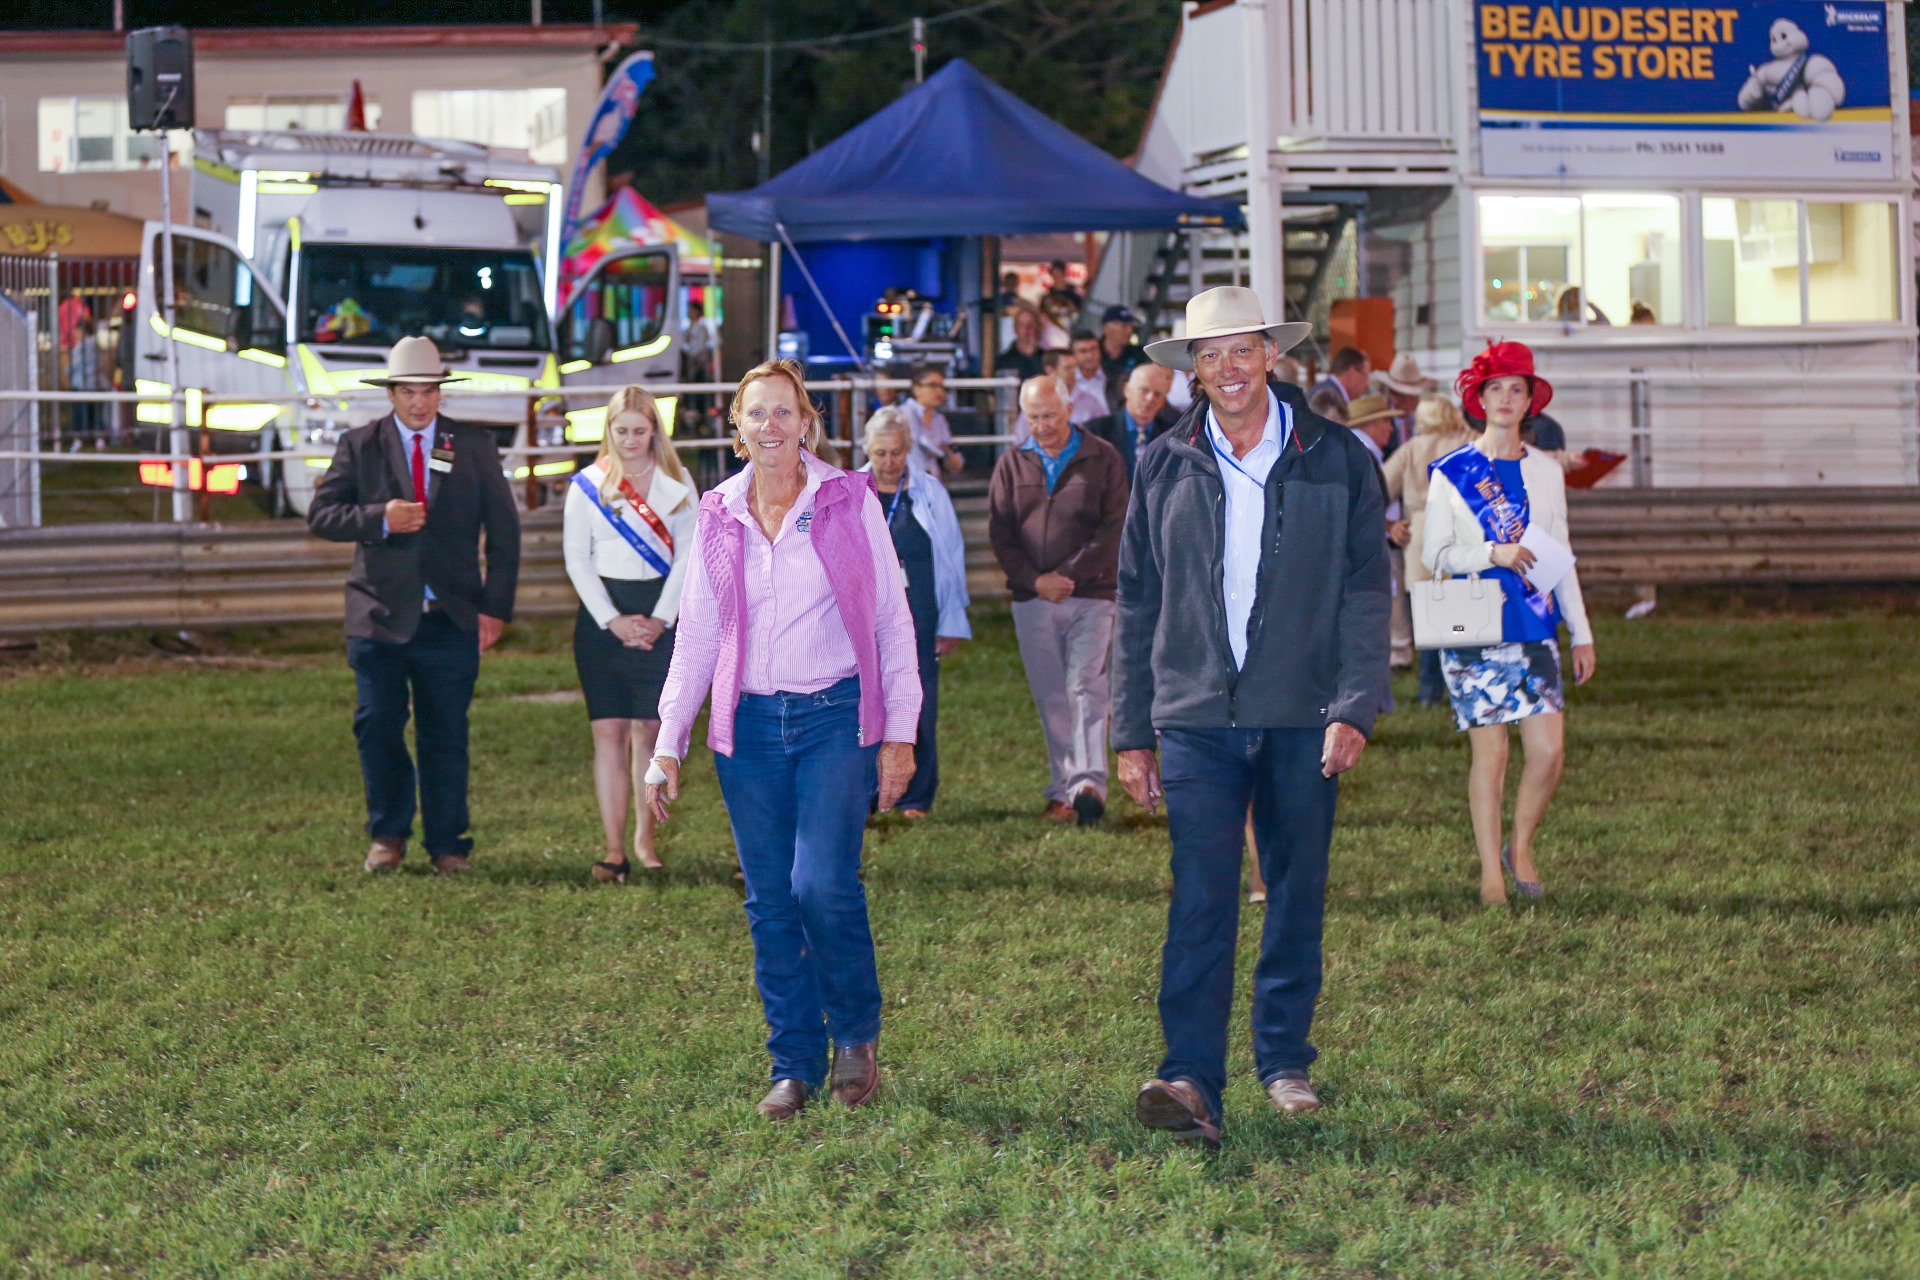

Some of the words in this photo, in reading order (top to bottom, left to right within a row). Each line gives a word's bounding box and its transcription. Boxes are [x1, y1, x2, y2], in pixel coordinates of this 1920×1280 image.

[1480, 4, 1739, 43] BEAUDESERT
[1482, 43, 1582, 78] TYRE
[1592, 45, 1715, 79] STORE
